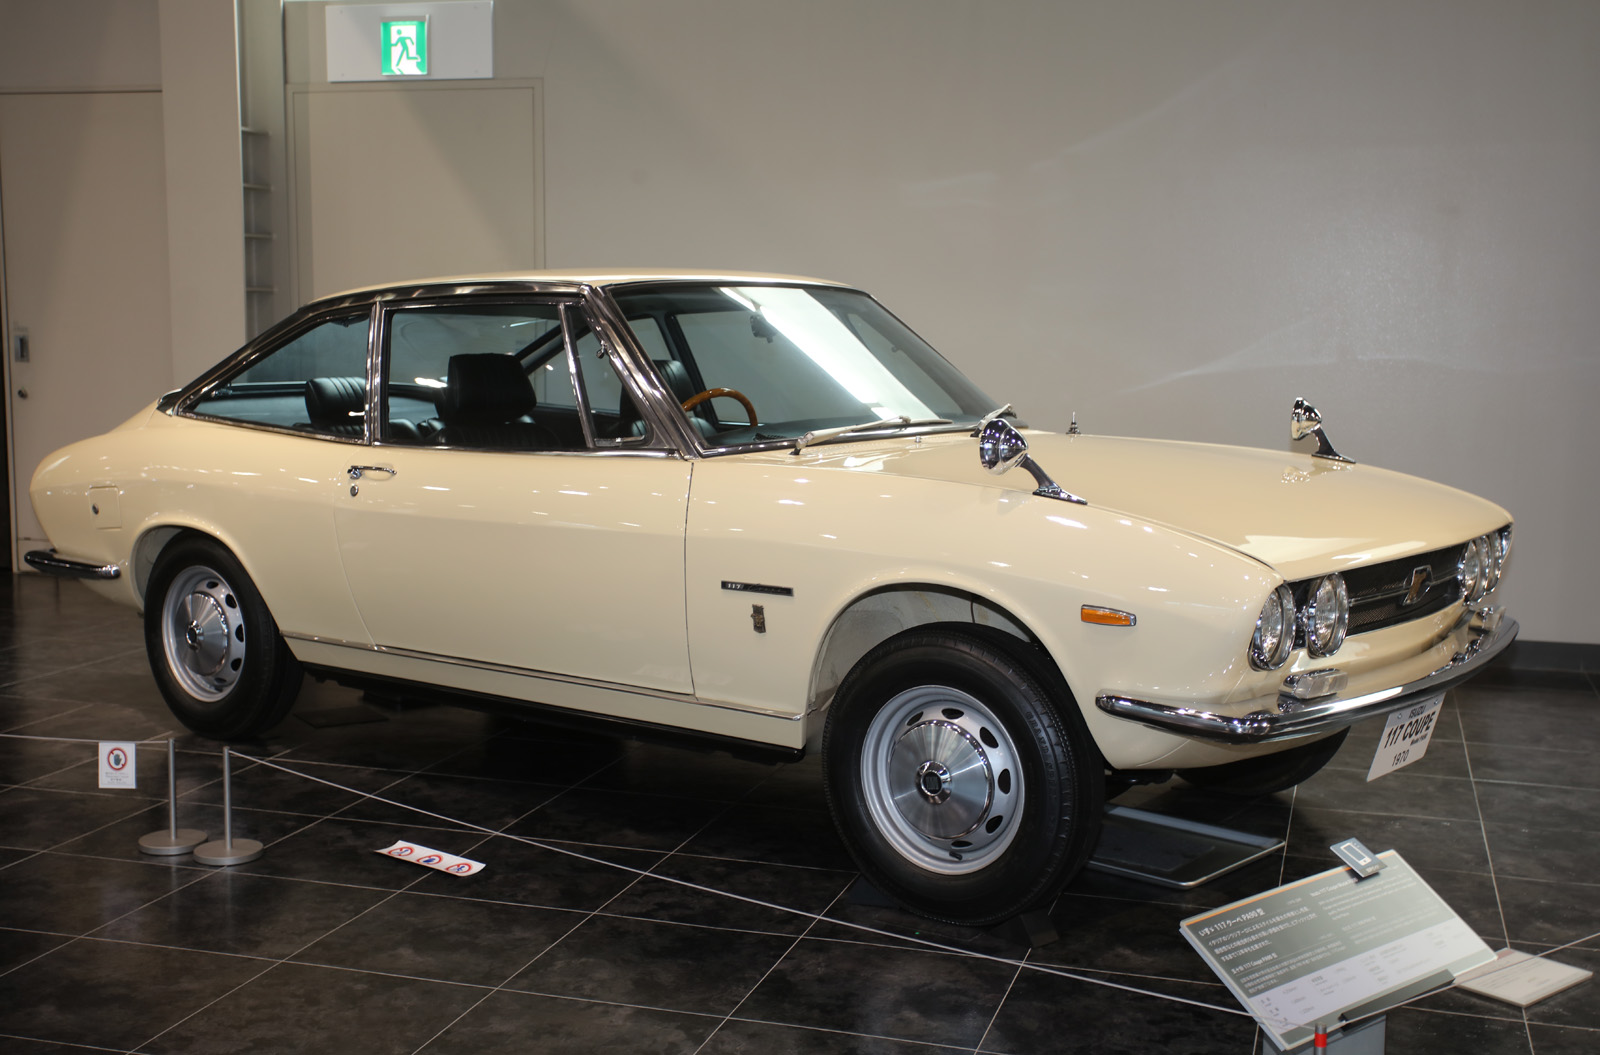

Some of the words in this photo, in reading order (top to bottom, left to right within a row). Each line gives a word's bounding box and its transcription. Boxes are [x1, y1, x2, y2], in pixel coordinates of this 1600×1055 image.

[1384, 724, 1406, 749] 117
[1402, 711, 1436, 741] COUPE
[1392, 749, 1410, 767] 1970
